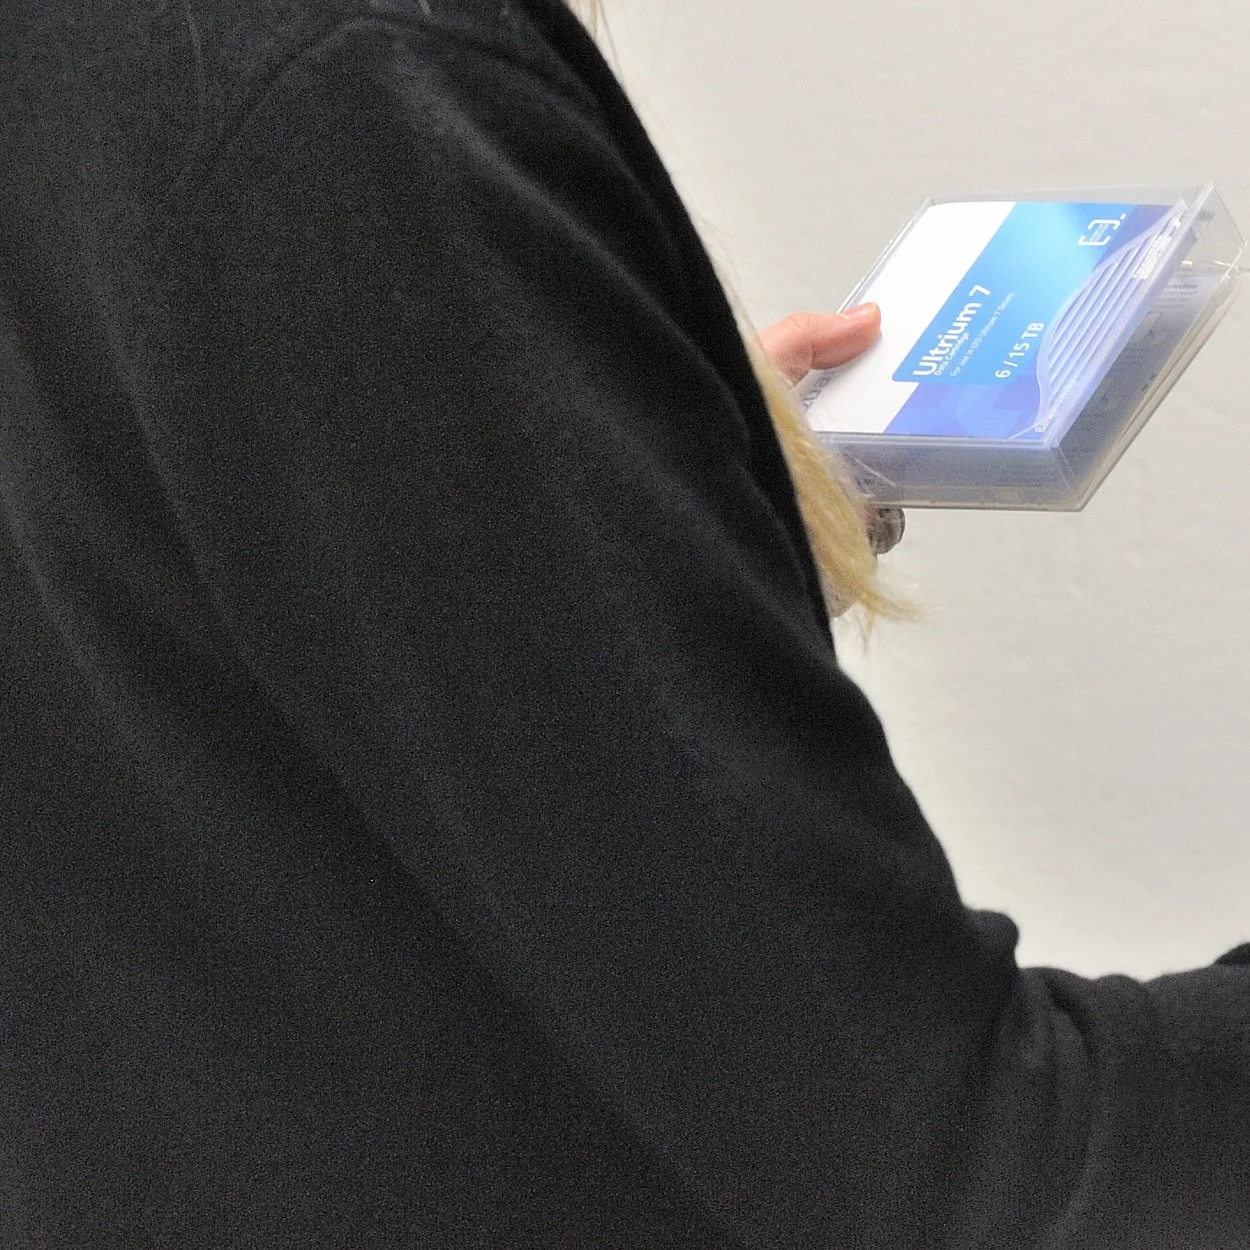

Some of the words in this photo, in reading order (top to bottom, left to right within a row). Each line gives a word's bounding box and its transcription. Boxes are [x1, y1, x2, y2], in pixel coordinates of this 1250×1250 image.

[912, 302, 982, 376] Ultrium
[968, 284, 991, 297] 7
[994, 368, 1012, 379] 6
[1008, 342, 1031, 359] 15
[1020, 322, 1045, 340] TB
